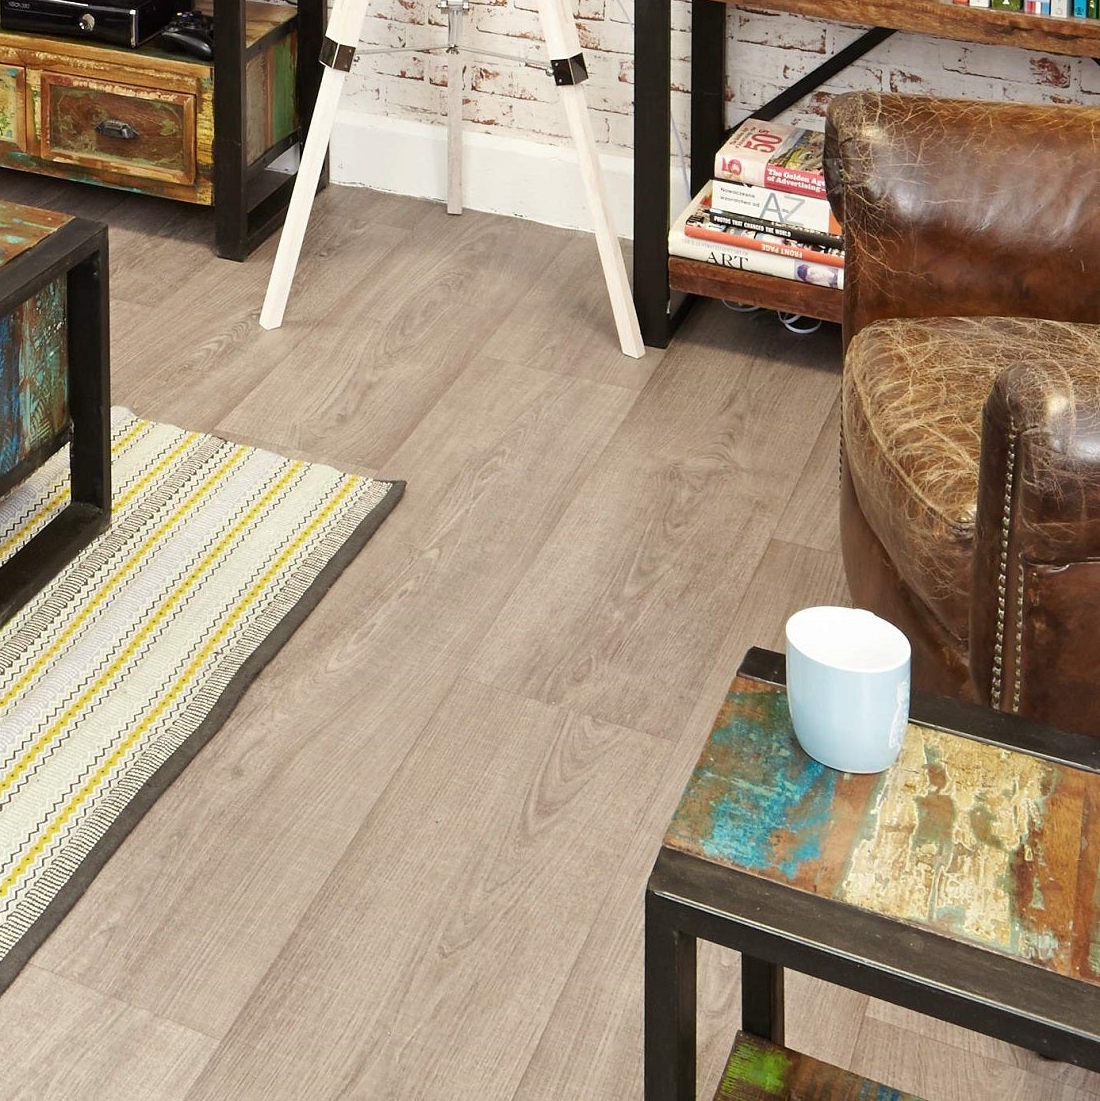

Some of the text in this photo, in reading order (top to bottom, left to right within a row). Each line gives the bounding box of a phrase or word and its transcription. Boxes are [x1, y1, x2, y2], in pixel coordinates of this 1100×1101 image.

[768, 168, 782, 177] The
[784, 172, 810, 182] Golden
[714, 216, 731, 225] PHOTOS
[744, 222, 764, 231] CHANGED
[775, 228, 791, 237] WORLD
[762, 244, 803, 258] FRONT PAGE
[708, 252, 748, 270] ART
